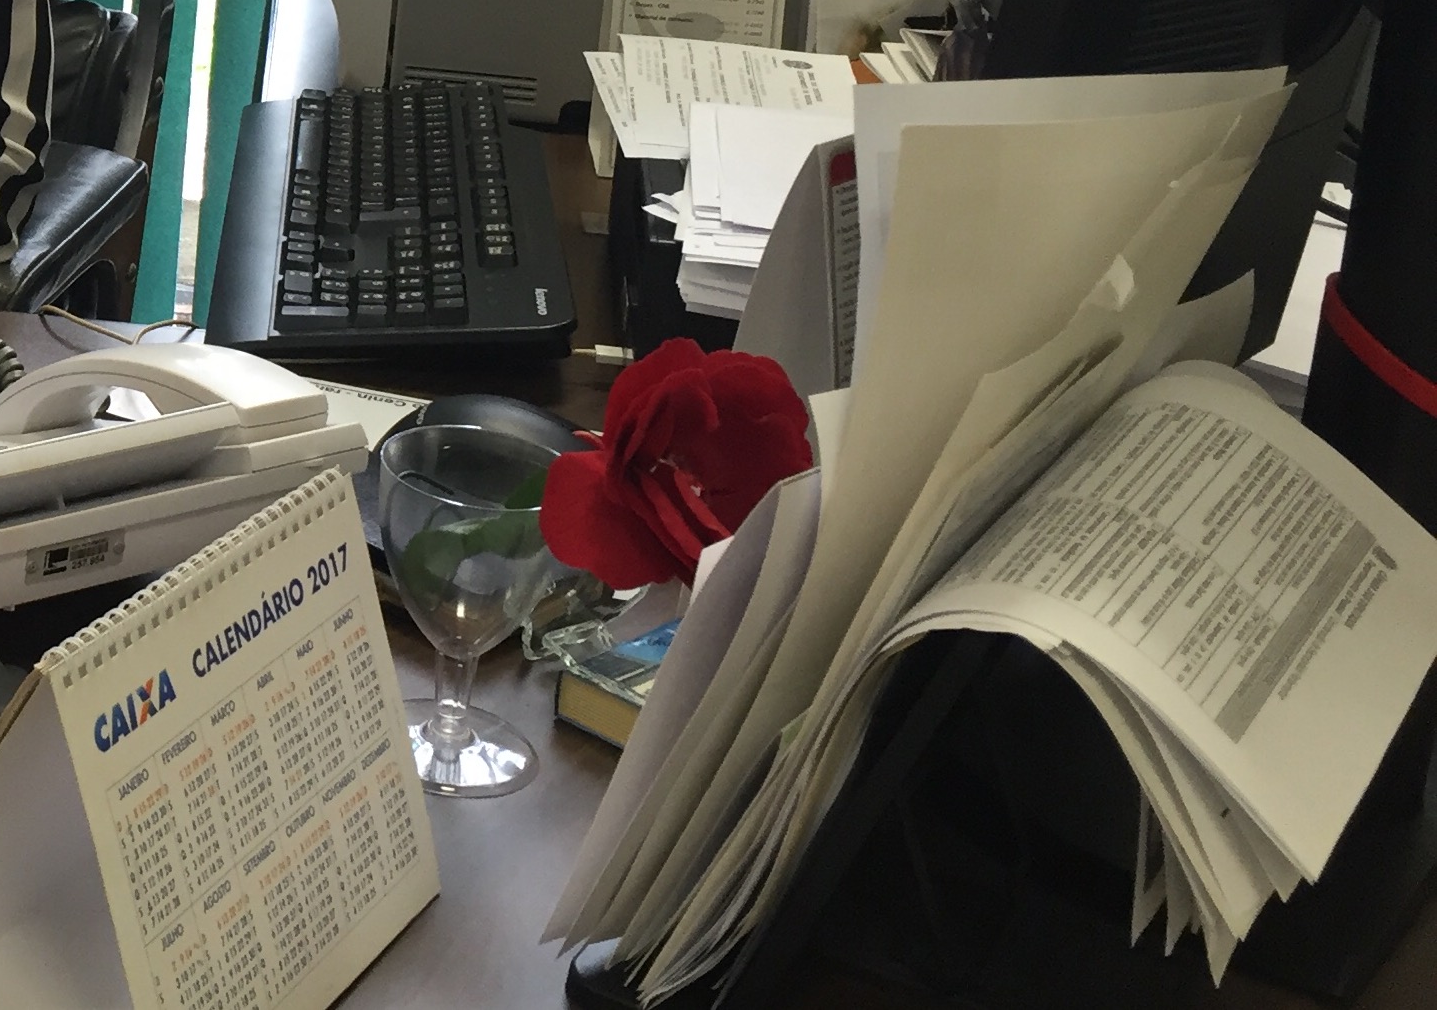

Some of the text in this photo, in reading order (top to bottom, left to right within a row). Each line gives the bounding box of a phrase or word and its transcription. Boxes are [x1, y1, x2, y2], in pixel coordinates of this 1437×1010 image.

[535, 287, 548, 318] lenovo
[192, 542, 348, 678] CALENDÁRIO 2017
[333, 608, 354, 632] JUNHO
[296, 640, 314, 659] MAIO
[256, 671, 274, 691] ABRIL
[94, 667, 177, 753] CAIXA
[210, 700, 235, 726] MARÇO
[161, 730, 197, 764] FEVEREIRO
[361, 738, 391, 771] DEZEMBRO
[119, 768, 150, 800] JANEIRO
[321, 768, 356, 805] NOVEMBRO
[285, 805, 315, 838] OUTUBRO
[242, 840, 276, 875] SETEMBRO
[203, 880, 232, 913] AGOSTO
[162, 923, 184, 951] JULHO
